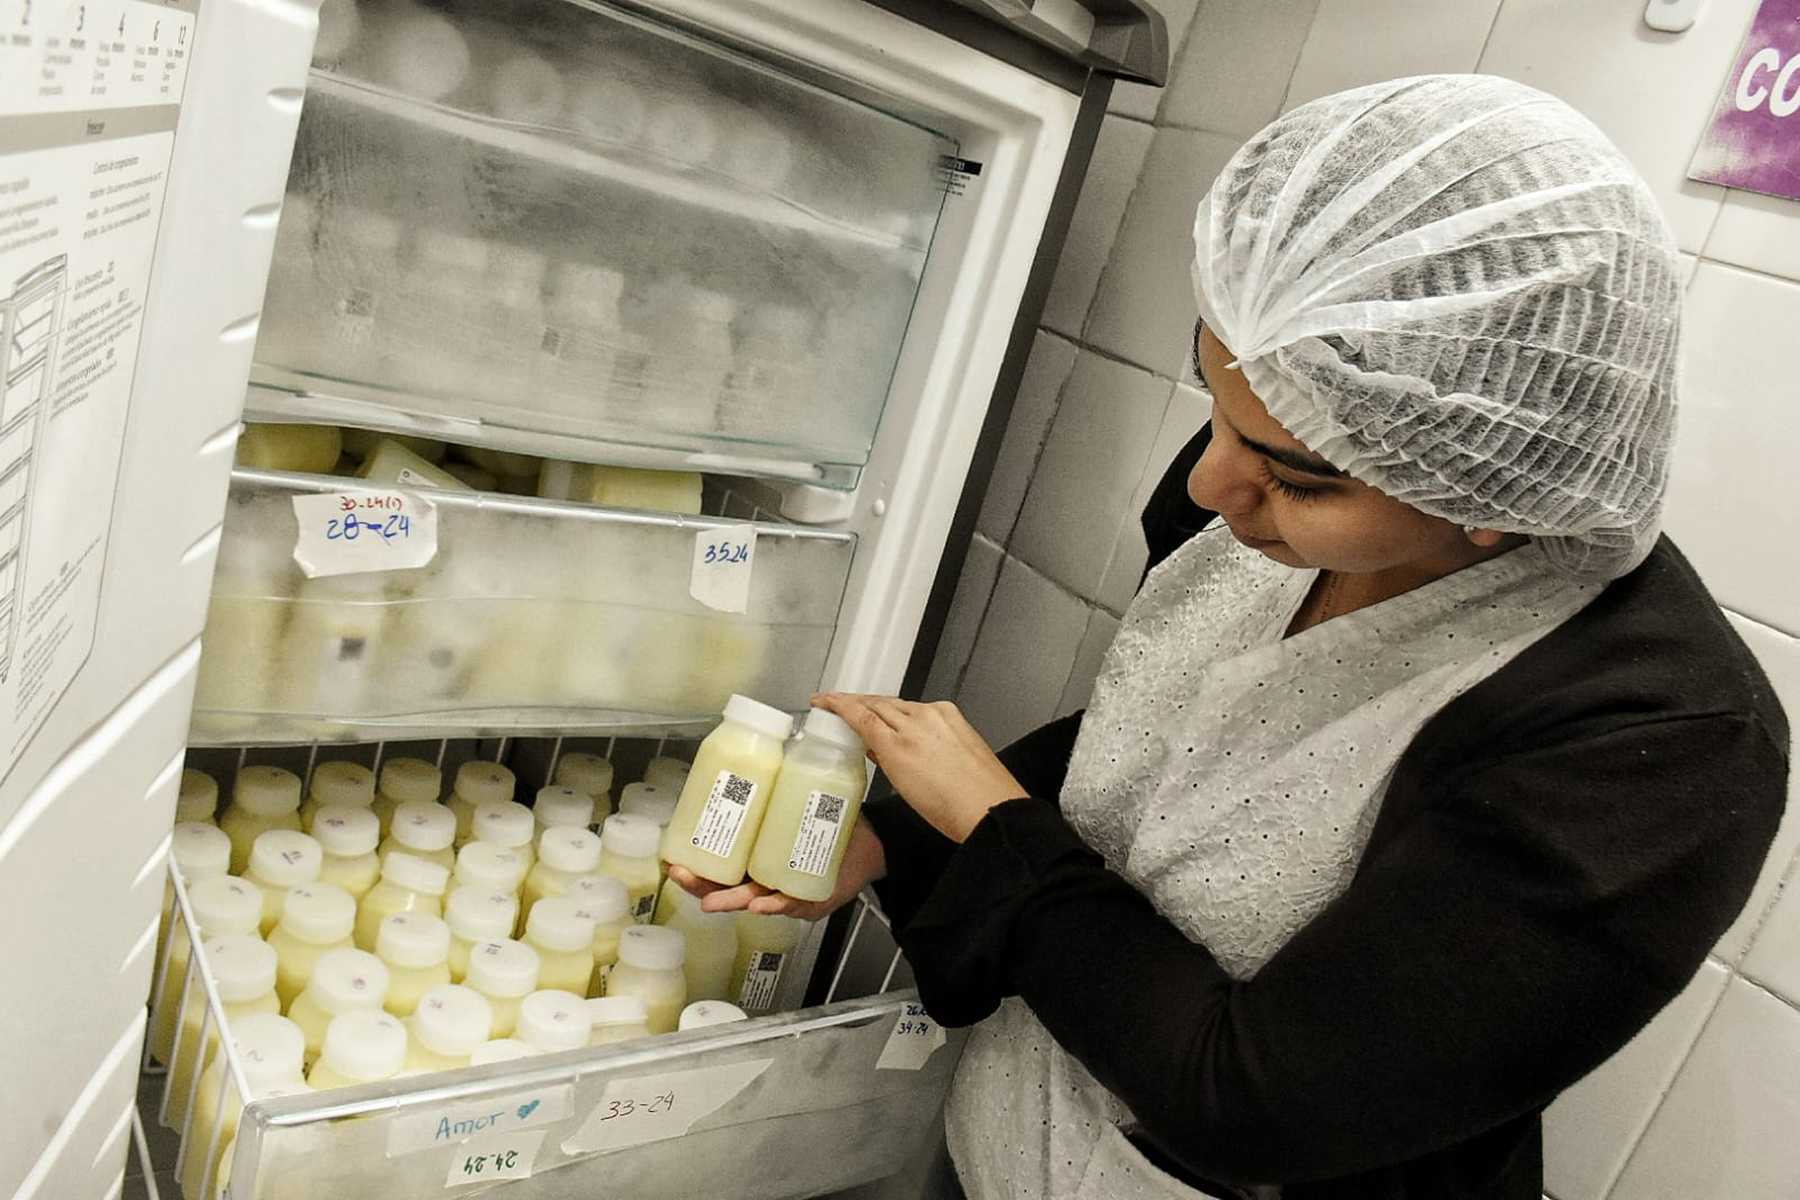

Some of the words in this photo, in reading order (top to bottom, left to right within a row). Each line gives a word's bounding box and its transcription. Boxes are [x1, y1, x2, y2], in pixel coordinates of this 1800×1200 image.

[76, 5, 86, 32] 3
[118, 12, 126, 37] 4
[153, 20, 160, 41] 6
[178, 25, 187, 46] 12
[600, 1090, 674, 1120] 33-24
[435, 1111, 505, 1140] Amor
